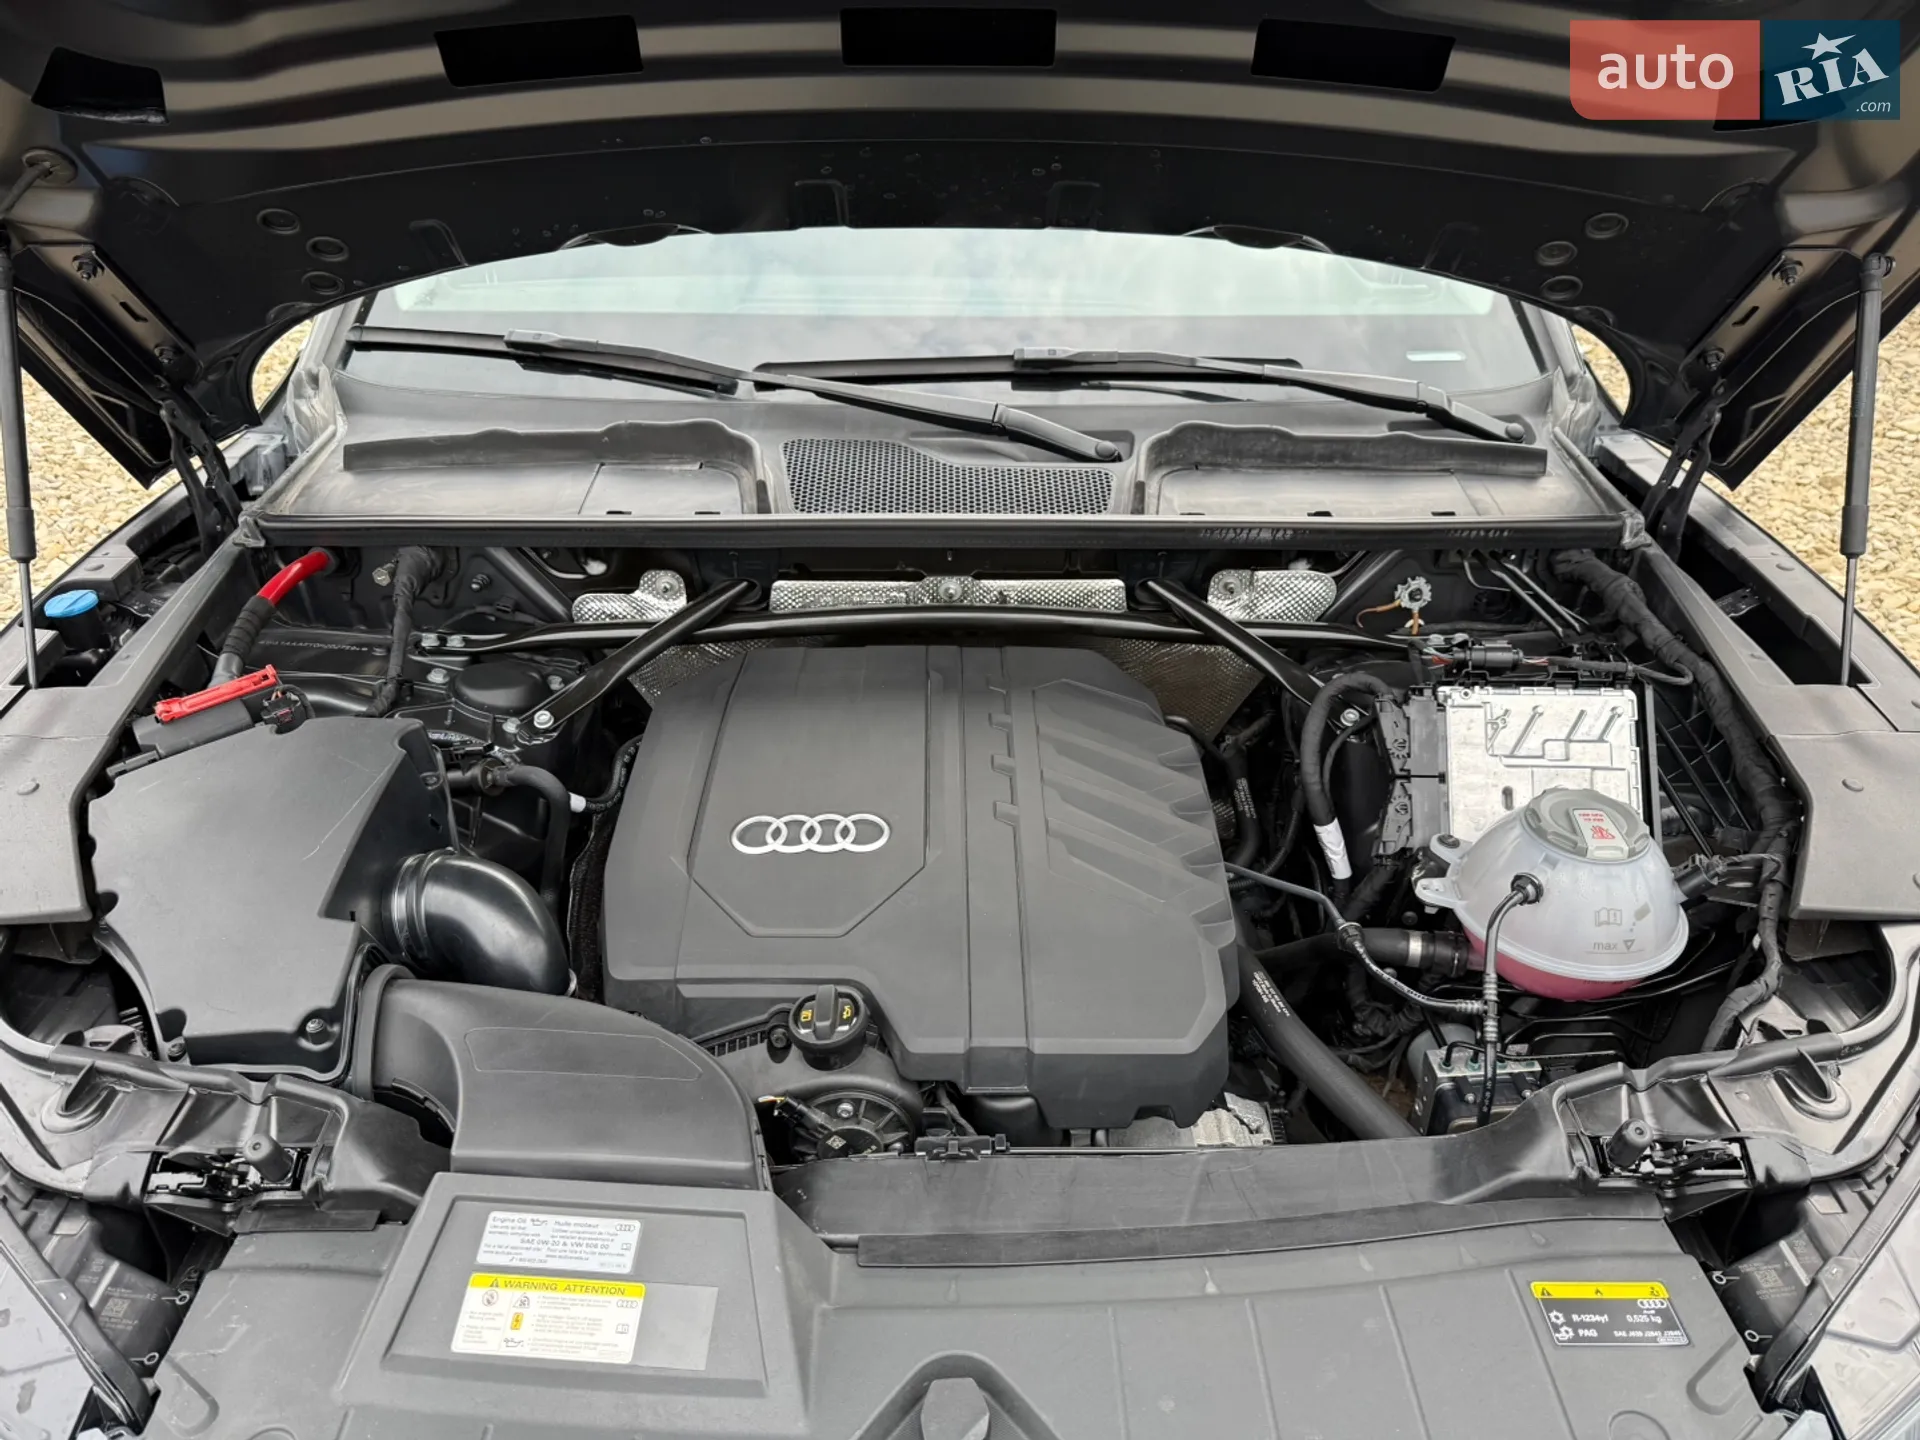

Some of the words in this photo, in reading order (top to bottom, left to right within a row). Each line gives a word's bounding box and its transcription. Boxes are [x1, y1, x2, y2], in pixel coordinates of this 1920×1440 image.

[1592, 941, 1618, 951] max
[492, 1216, 515, 1225] Engine
[503, 1280, 557, 1291] WARNING
[562, 1283, 625, 1295] ATTENTION
[1649, 1314, 1663, 1324] kg
